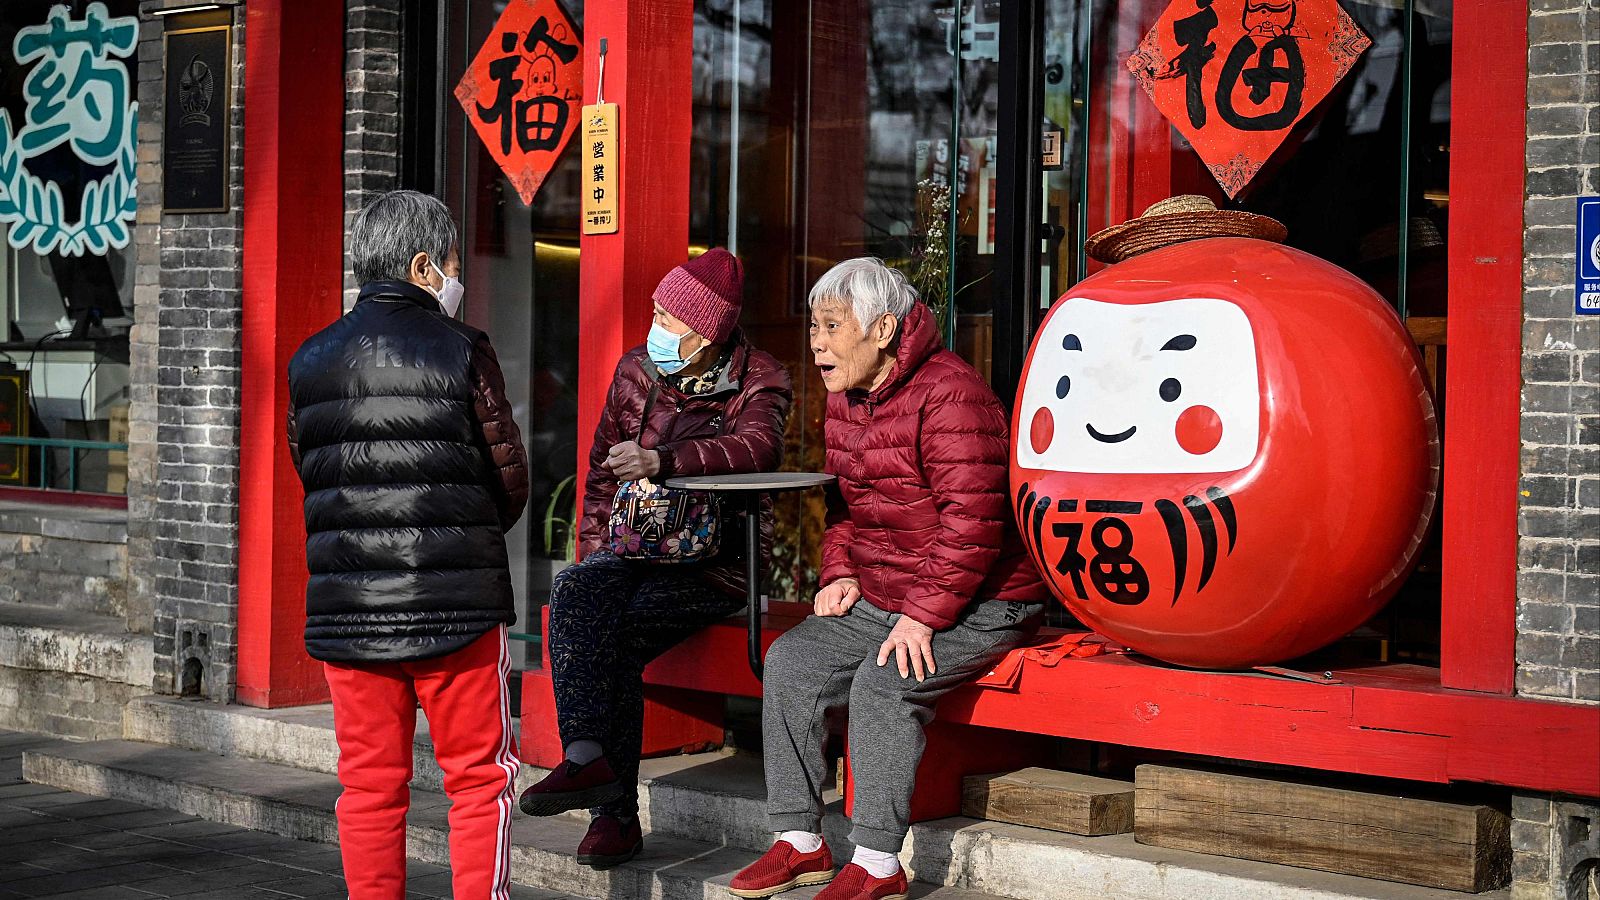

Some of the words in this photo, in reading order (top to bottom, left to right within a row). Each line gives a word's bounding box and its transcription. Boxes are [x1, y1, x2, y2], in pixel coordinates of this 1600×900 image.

[16, 9, 137, 160] 药
[476, 16, 578, 156] 福
[593, 141, 604, 204] 営業中
[1051, 499, 1150, 605] 福
